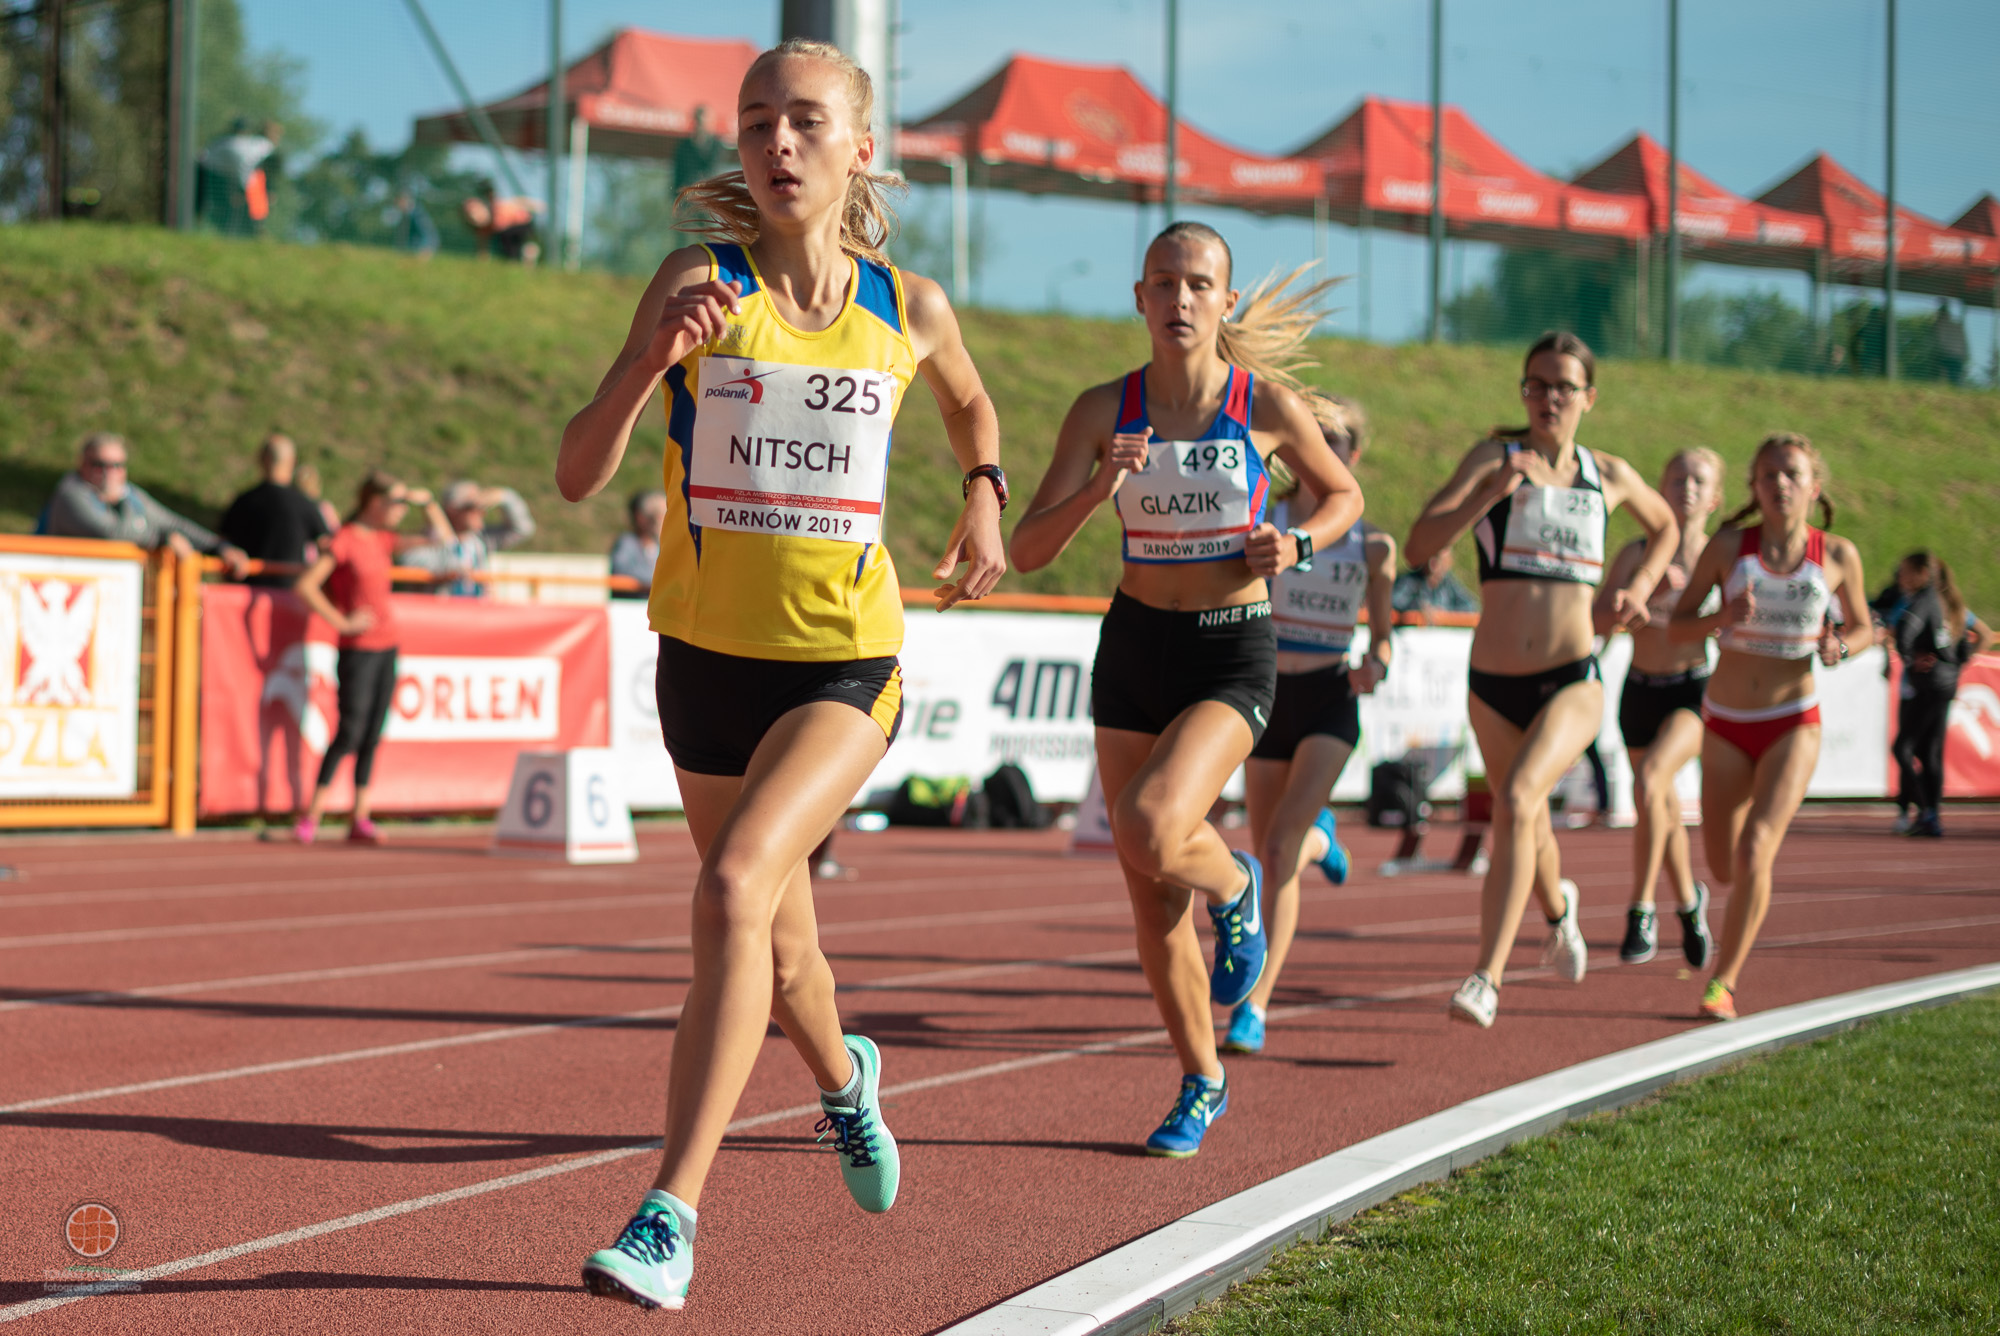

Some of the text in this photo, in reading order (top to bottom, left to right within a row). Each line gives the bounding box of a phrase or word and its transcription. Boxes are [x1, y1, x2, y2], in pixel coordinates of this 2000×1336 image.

[705, 387, 750, 400] polanik
[804, 373, 881, 416] 325
[729, 434, 851, 474] NITSCH
[1182, 446, 1239, 472] 493
[752, 491, 801, 501] MISTRZOSTWA
[802, 495, 827, 504] POLSKI
[771, 499, 803, 508] JANUSZA
[1140, 490, 1222, 516] GLAZIK
[717, 507, 852, 535] TARNÓW 2019
[1143, 540, 1231, 556] TARNÓW 2019
[1199, 600, 1273, 627] NIKE PRO
[392, 675, 545, 721] ORLEN
[521, 771, 556, 829] 6
[586, 773, 610, 829] 6
